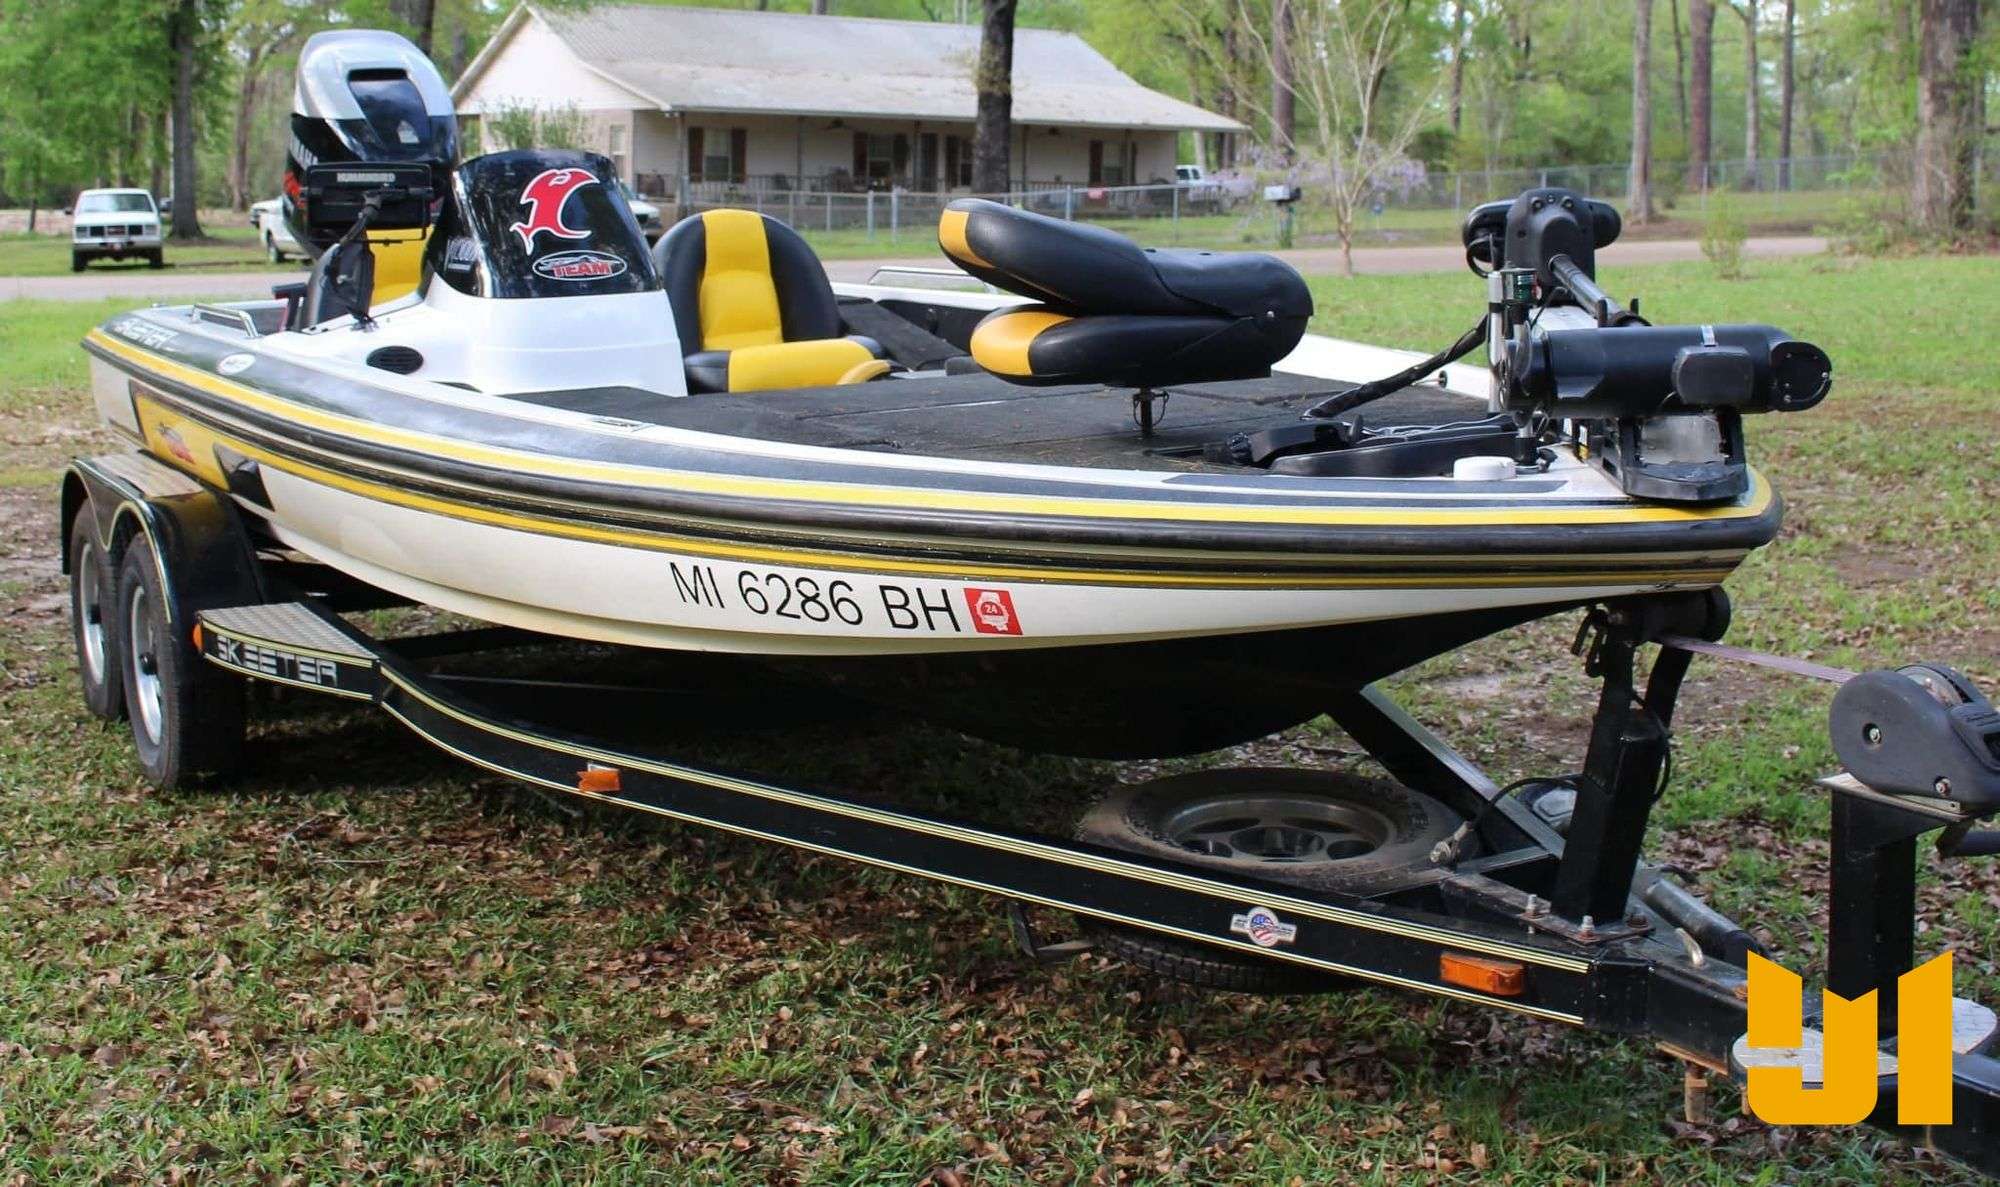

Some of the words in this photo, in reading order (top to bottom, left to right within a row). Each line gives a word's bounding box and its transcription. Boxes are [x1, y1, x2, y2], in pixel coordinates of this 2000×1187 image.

[553, 261, 612, 278] TEAM
[669, 561, 725, 609] MI
[737, 569, 863, 626] 6286
[878, 584, 962, 632] BH
[983, 604, 998, 614] 24
[217, 635, 338, 688] SKEETER
